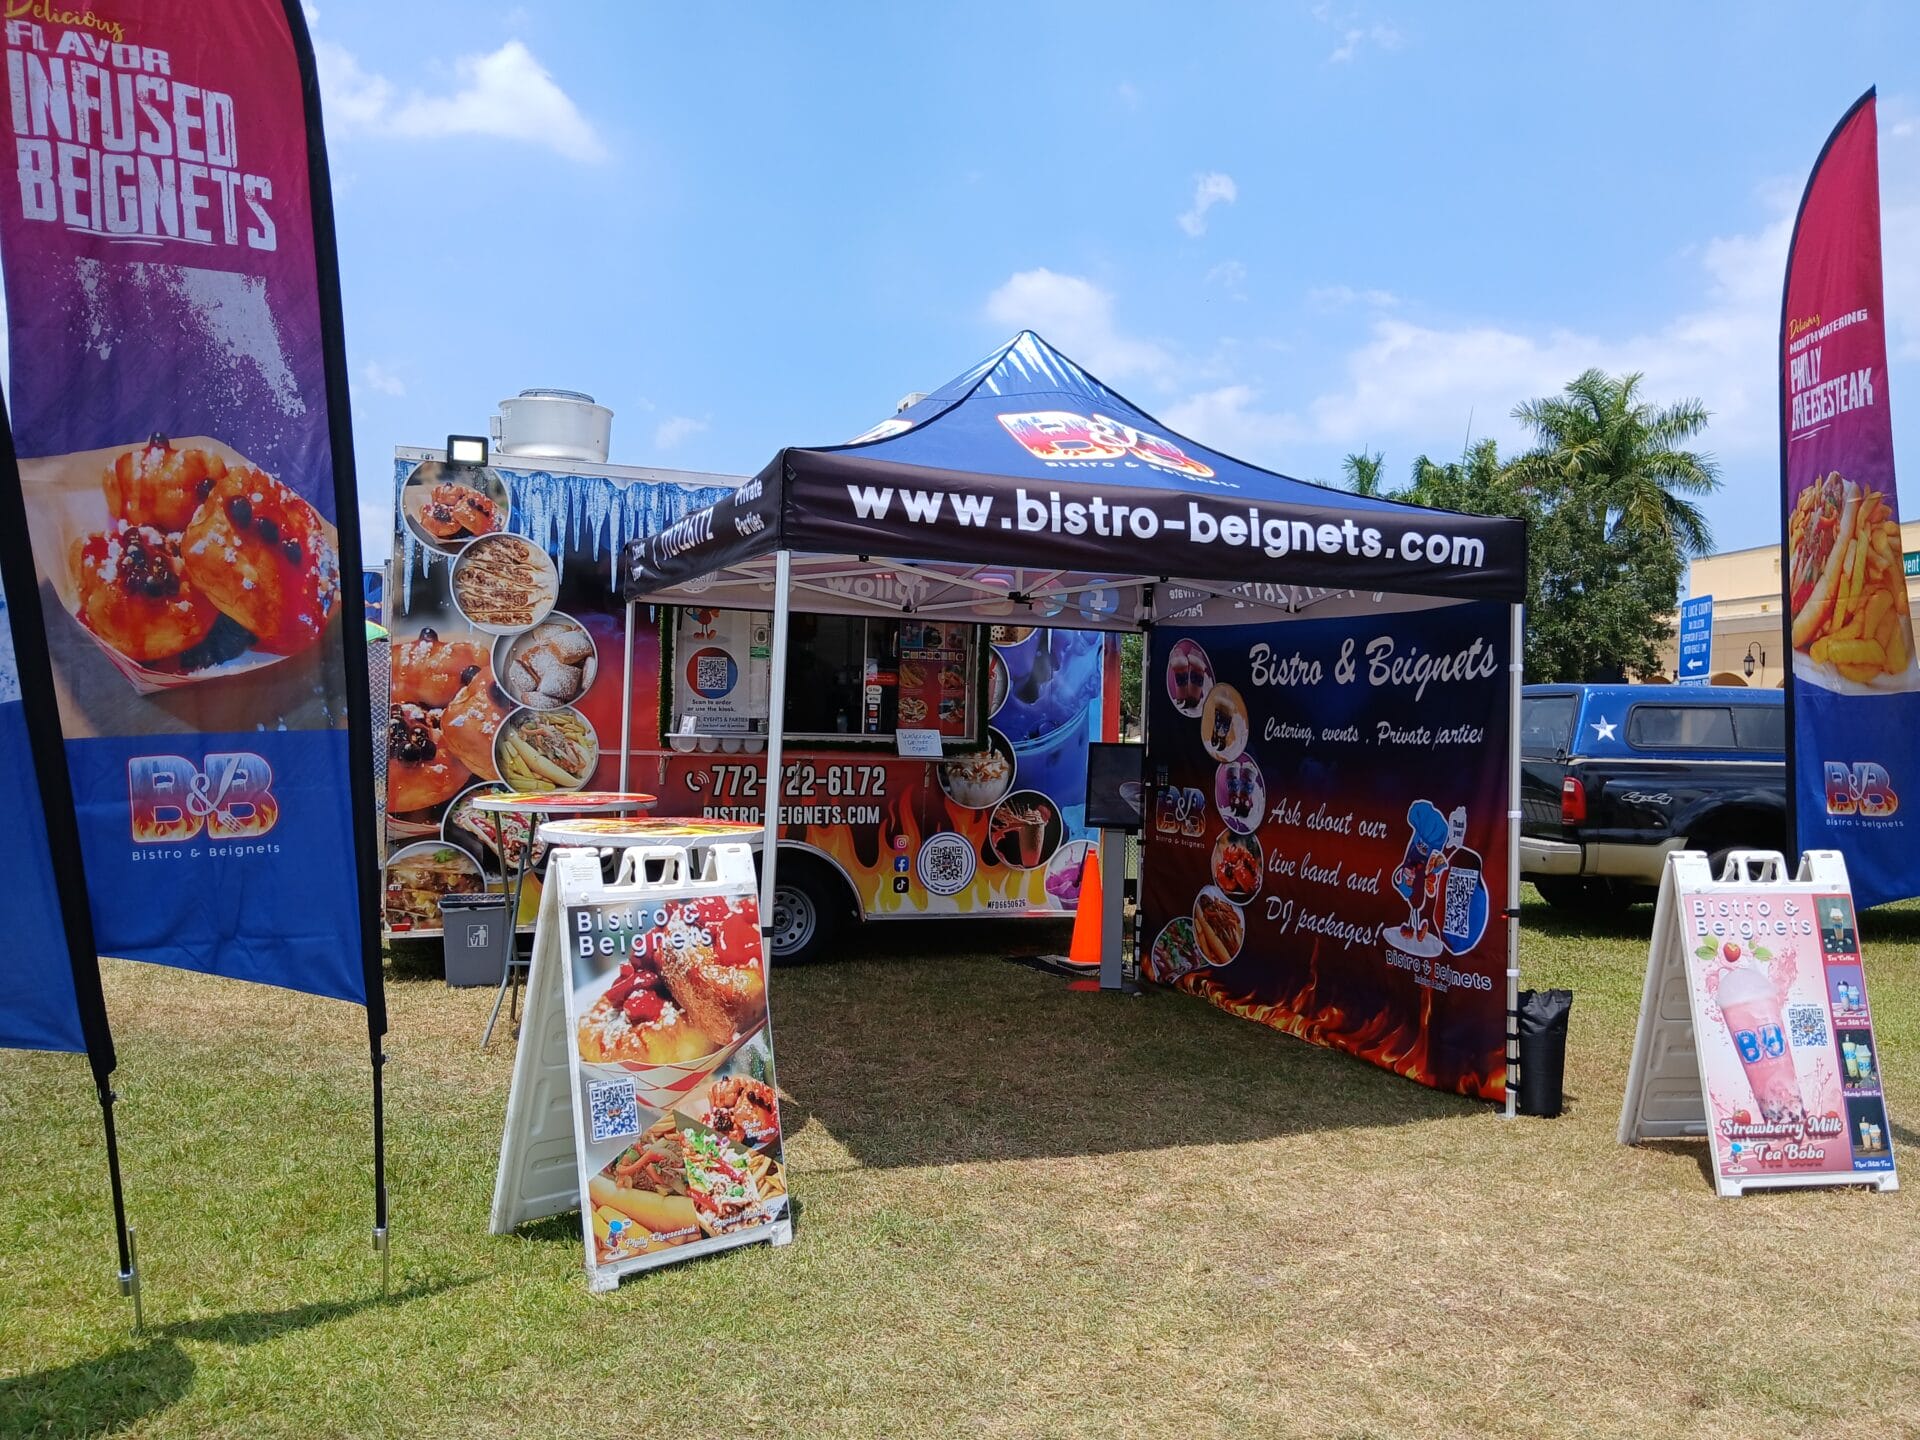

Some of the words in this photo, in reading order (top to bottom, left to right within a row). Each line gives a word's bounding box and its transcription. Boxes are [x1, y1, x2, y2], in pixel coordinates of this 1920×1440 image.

[4, 19, 171, 76] FLAVOR
[6, 49, 238, 168] INFUSED
[15, 137, 277, 251] BEIGNETS
[1790, 308, 1868, 354] MOUTHWATERING
[734, 511, 765, 537] Parties
[847, 484, 1485, 568] www.bistro-beignets.com
[1249, 642, 1324, 687] Bistro
[1334, 637, 1357, 685] &
[1365, 635, 1498, 702] Beignets
[1322, 726, 1359, 742] events
[1376, 720, 1432, 746] Private
[711, 765, 886, 796] 772-22-6172
[1823, 761, 1899, 817] B&B
[128, 752, 278, 843] B&B
[703, 806, 880, 824] BISTRO-EIGNETS.COM
[1268, 797, 1301, 826] Ask
[1306, 802, 1353, 835] about
[1358, 819, 1388, 839] our
[1825, 818, 1852, 826] Bistro
[132, 849, 182, 861] Bistro
[190, 849, 201, 858] &
[209, 843, 280, 858] Beignets
[1268, 848, 1295, 875] live
[1300, 852, 1341, 886] band
[1346, 866, 1381, 895] and
[577, 907, 669, 933] Bistro
[683, 902, 700, 925] &
[1265, 895, 1293, 933] DJ
[1298, 913, 1385, 951] packages!
[1693, 898, 1771, 917] Bistro
[1784, 899, 1799, 916] &
[578, 926, 714, 958] Beignets
[1695, 916, 1812, 940] Beignets
[1385, 949, 1421, 972] Bistro
[1422, 959, 1431, 975] &
[1434, 962, 1493, 991] Beignets
[1719, 1117, 1805, 1140] Strawberry
[1808, 1115, 1842, 1133] Milk
[1754, 1143, 1782, 1161] Tea
[1784, 1142, 1825, 1160] Boba
[624, 1236, 649, 1249] Philly
[650, 1224, 697, 1242] Cheesesteak
